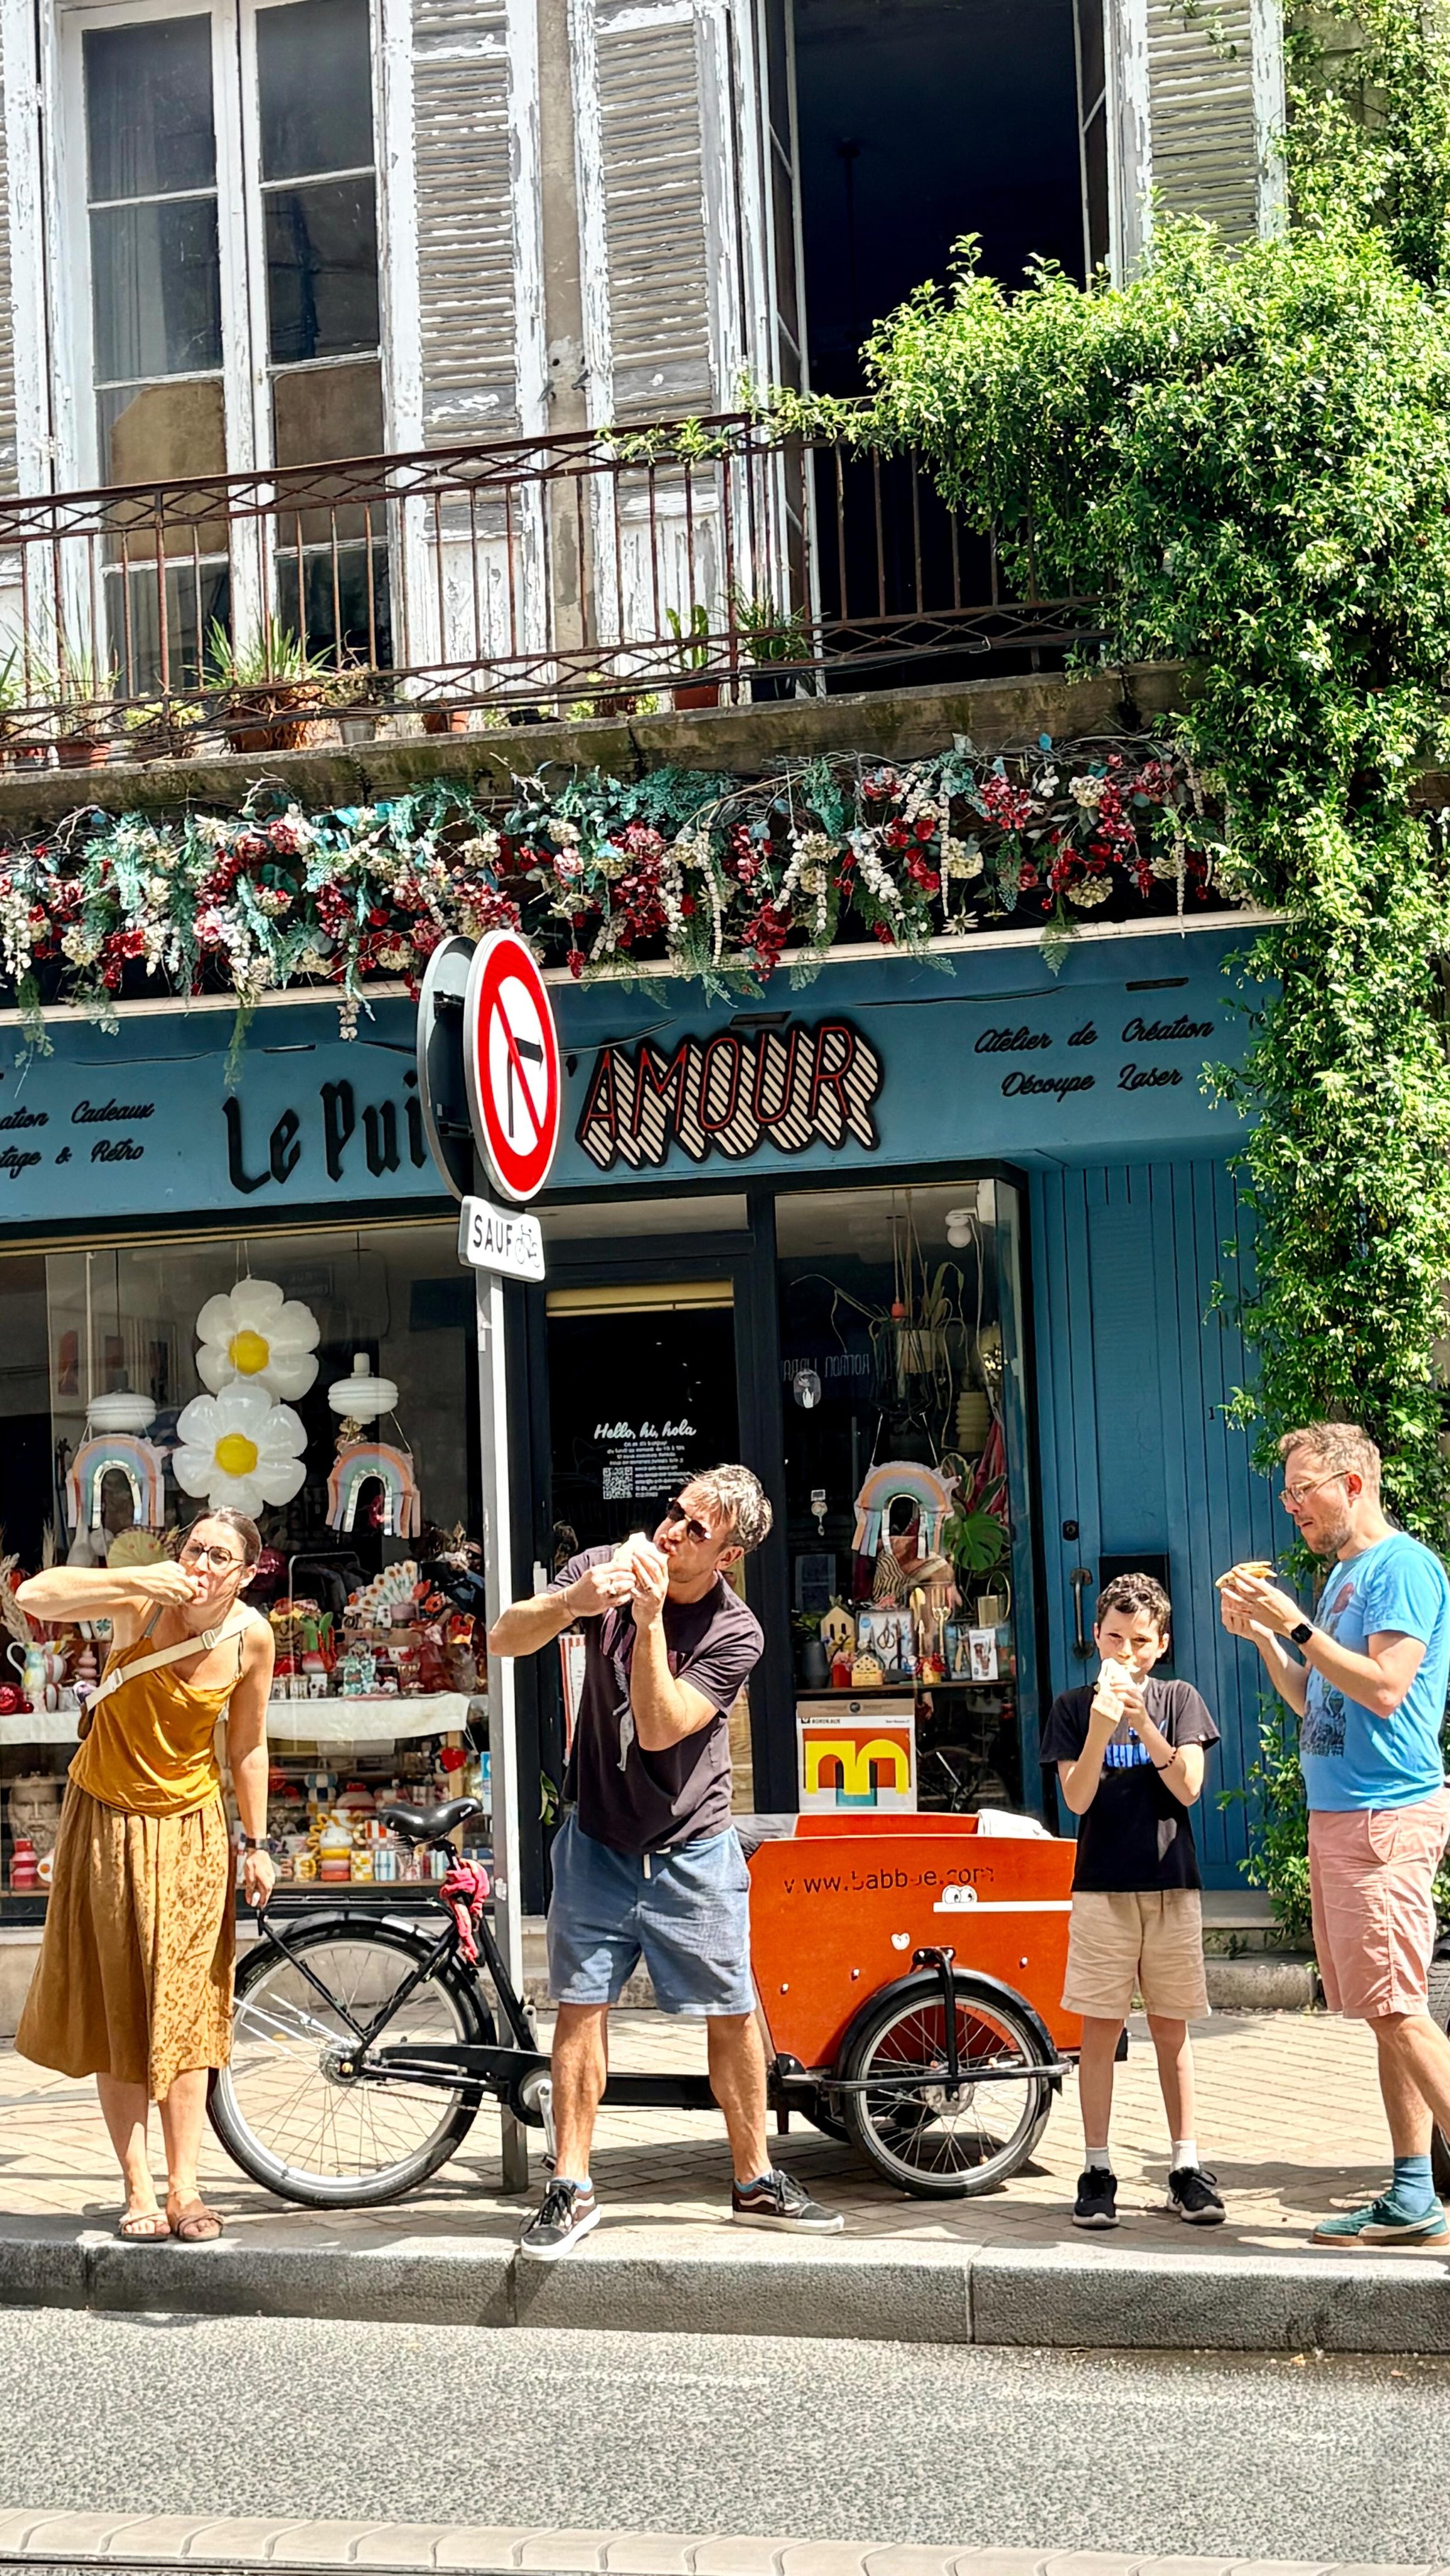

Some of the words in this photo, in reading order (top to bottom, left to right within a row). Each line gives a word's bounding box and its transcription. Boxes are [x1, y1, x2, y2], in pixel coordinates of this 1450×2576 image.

[975, 1026, 1052, 1053] Atelier
[1067, 1021, 1098, 1046] de
[1122, 1014, 1214, 1042] Création
[1001, 1072, 1095, 1102] Découpe
[1117, 1063, 1183, 1091] Laser
[0, 1106, 49, 1130] ation
[71, 1098, 155, 1124] Cadeaux
[222, 1096, 301, 1194] Le
[319, 1069, 427, 1183] Pui
[0, 1145, 42, 1180] tage
[55, 1146, 72, 1164] &
[472, 1214, 513, 1257] SAUF
[594, 1422, 636, 1439] Hello,
[639, 1421, 659, 1438] hi,
[662, 1419, 696, 1436] hola
[783, 1867, 995, 1894] www.babbe.com
